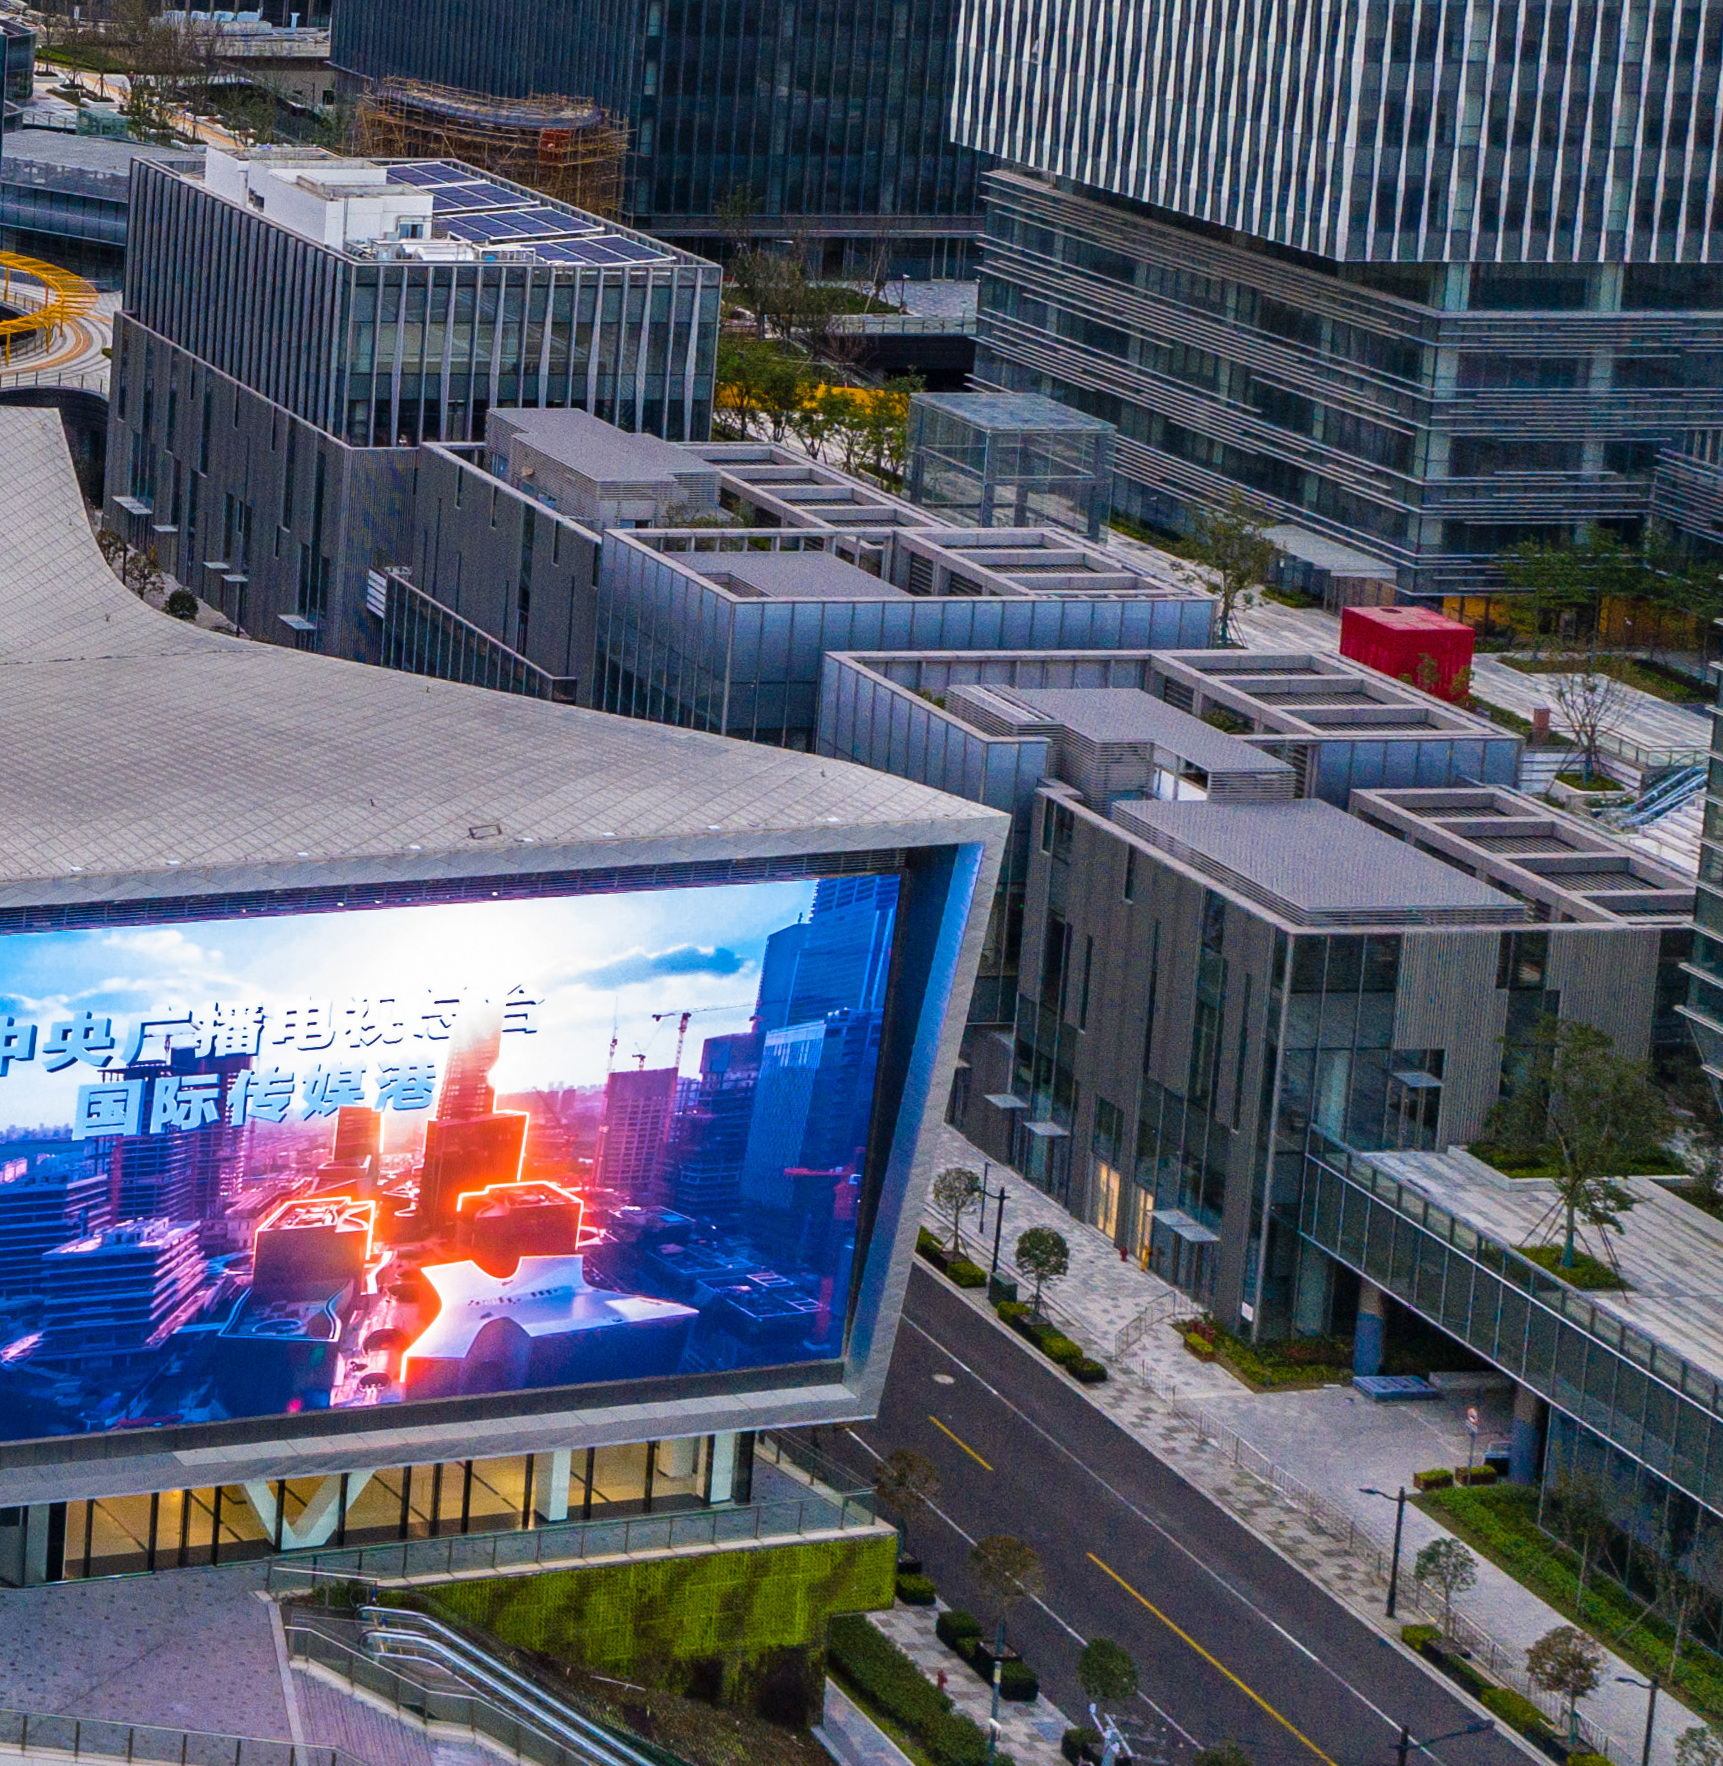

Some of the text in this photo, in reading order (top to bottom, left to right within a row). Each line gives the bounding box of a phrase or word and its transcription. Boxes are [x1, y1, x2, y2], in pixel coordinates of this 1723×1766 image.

[72, 1056, 438, 1141] 国际传媒港
